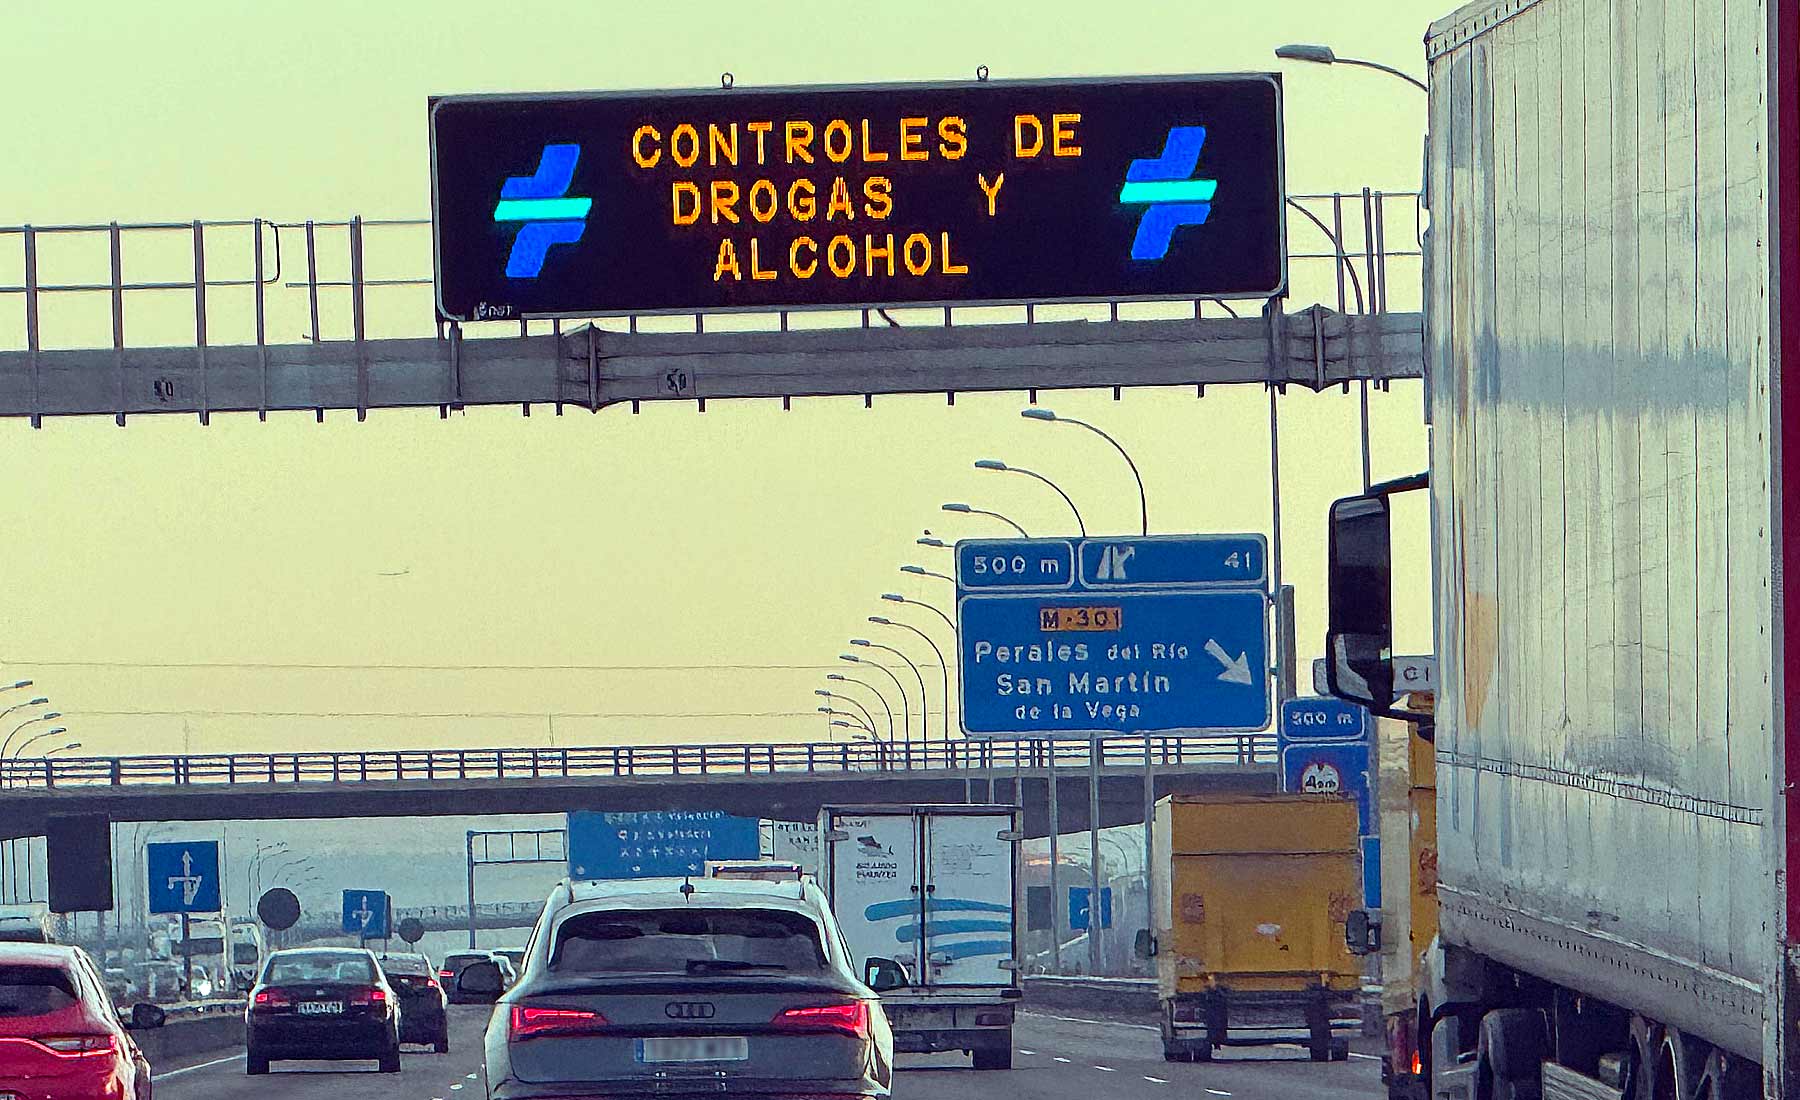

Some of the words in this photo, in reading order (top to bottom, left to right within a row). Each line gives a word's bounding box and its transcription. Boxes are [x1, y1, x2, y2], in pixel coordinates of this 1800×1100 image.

[631, 115, 969, 170] CONTROLES
[1013, 112, 1083, 159] DE
[671, 176, 894, 226] DROGAS
[977, 173, 1004, 218] Y
[712, 230, 970, 283] ALCOHOL
[973, 556, 1026, 574] 500
[1040, 558, 1059, 574] m
[1223, 551, 1251, 572] 41
[974, 640, 1089, 663] Perales
[1107, 643, 1140, 660] del
[1152, 643, 1189, 659] Río
[996, 673, 1053, 696] San
[1068, 670, 1171, 695] Martín
[1014, 703, 1041, 720] de
[1052, 702, 1073, 719] la
[1084, 701, 1141, 722] Vega
